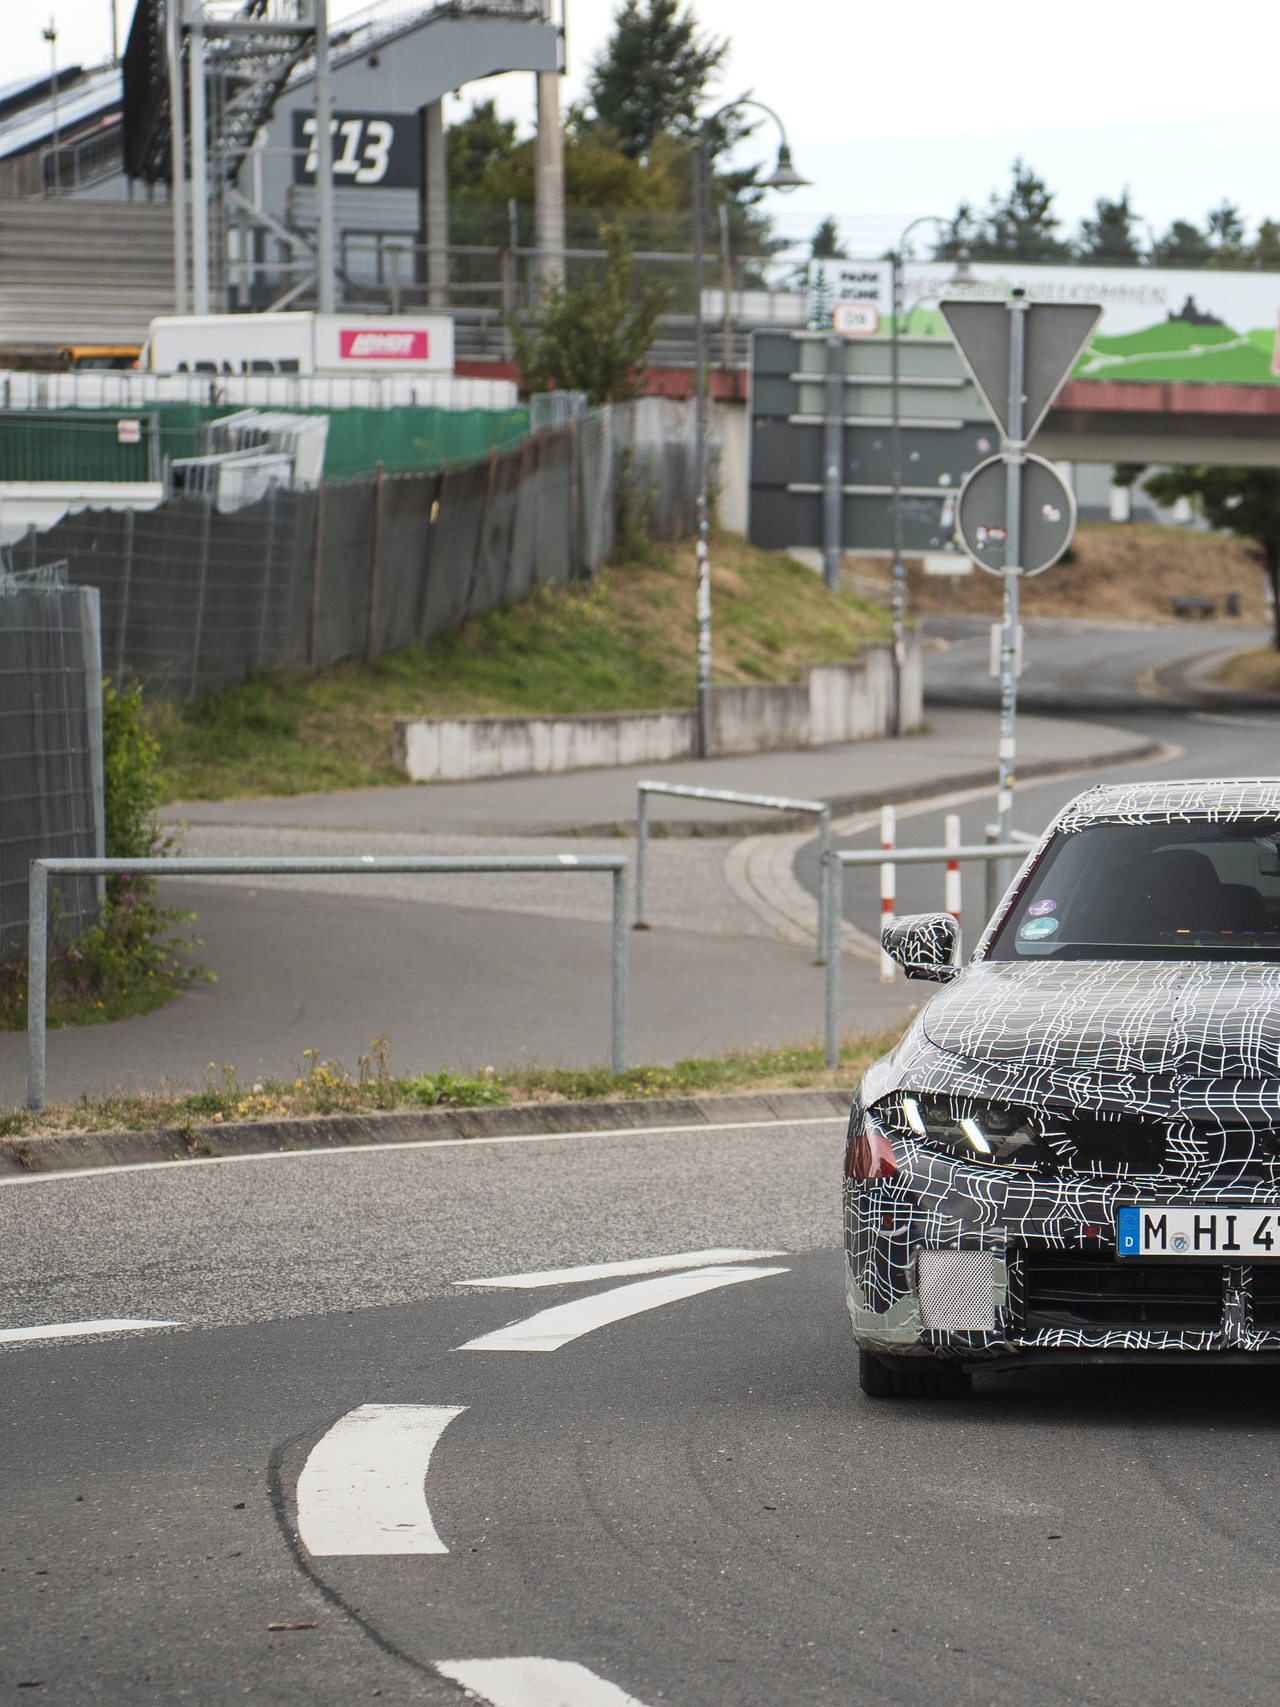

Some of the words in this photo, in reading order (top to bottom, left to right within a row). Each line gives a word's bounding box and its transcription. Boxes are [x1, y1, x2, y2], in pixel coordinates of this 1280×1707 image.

[1125, 1236, 1134, 1248] D
[1144, 1214, 1167, 1250] M
[1194, 1214, 1241, 1251] HI
